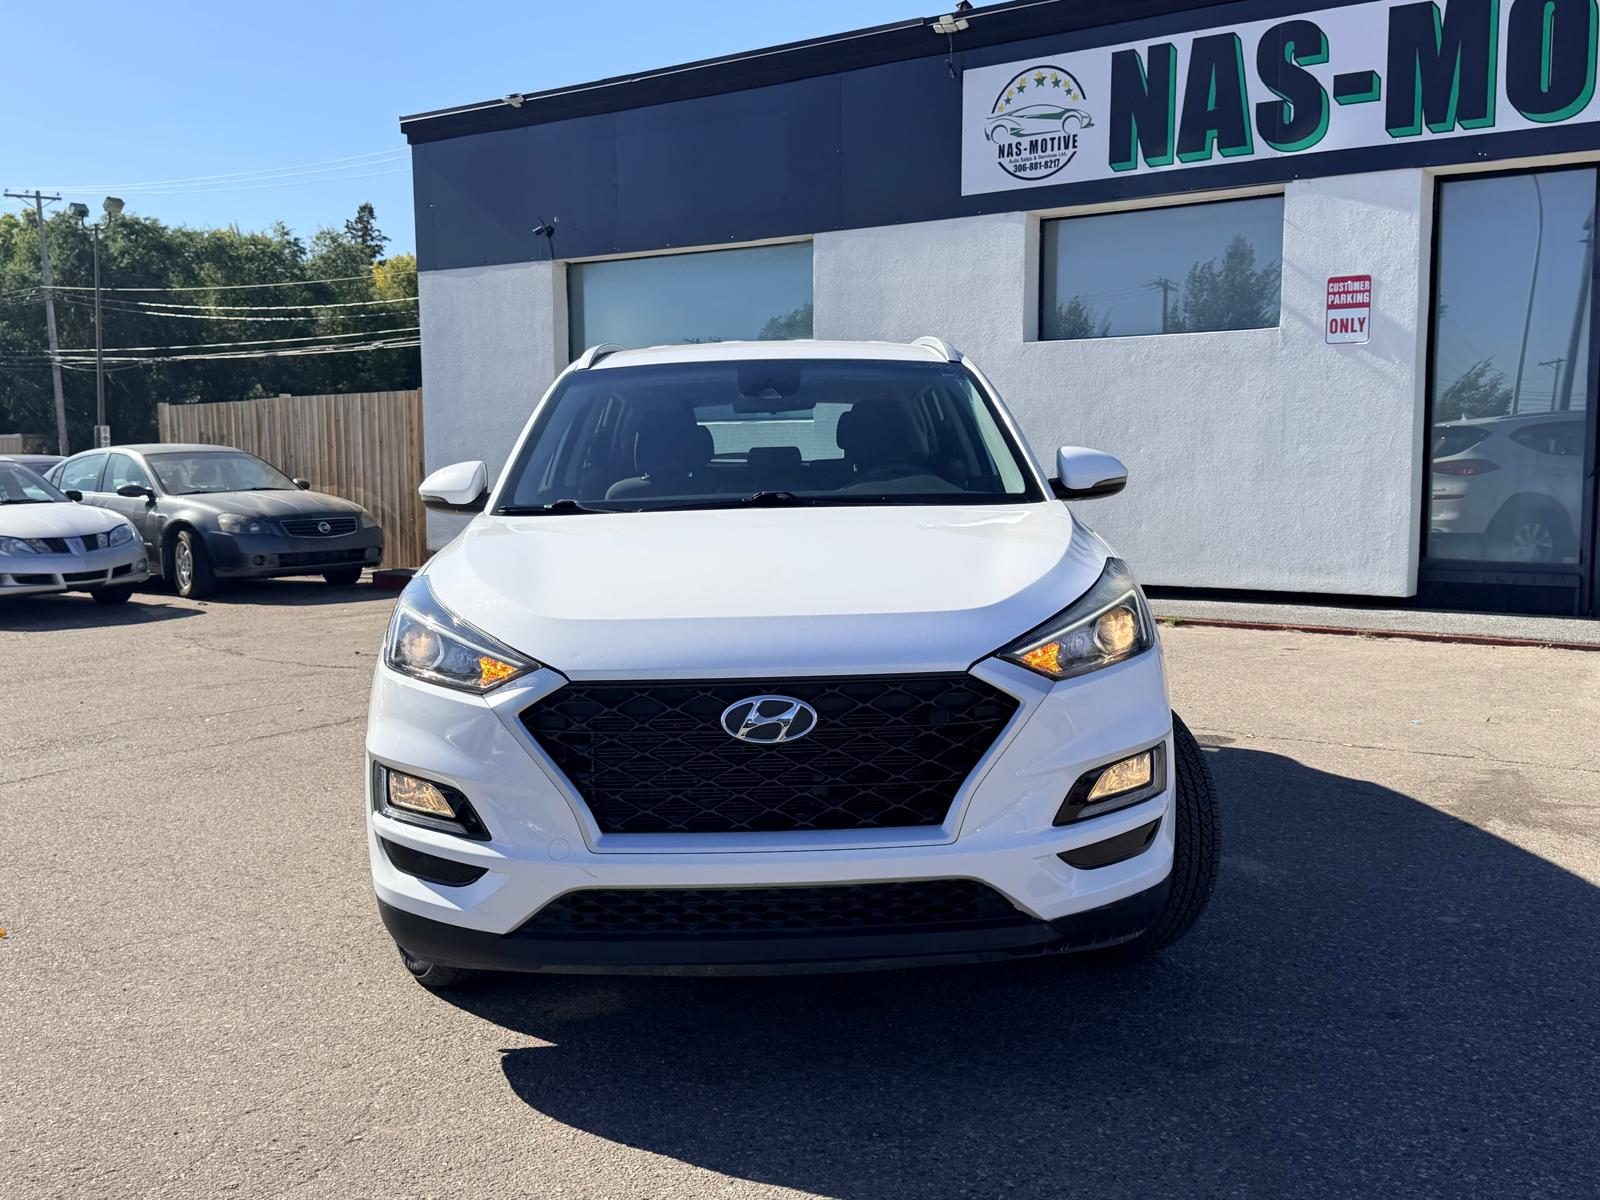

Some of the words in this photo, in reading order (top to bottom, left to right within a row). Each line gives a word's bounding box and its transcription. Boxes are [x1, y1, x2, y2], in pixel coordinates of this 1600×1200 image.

[1109, 0, 1599, 172] NAS-MO
[998, 133, 1078, 159] NAS-MOTIVE
[1328, 281, 1370, 292] CUSTOMER
[1328, 292, 1369, 305] PARKING
[1329, 316, 1366, 334] ONLY
